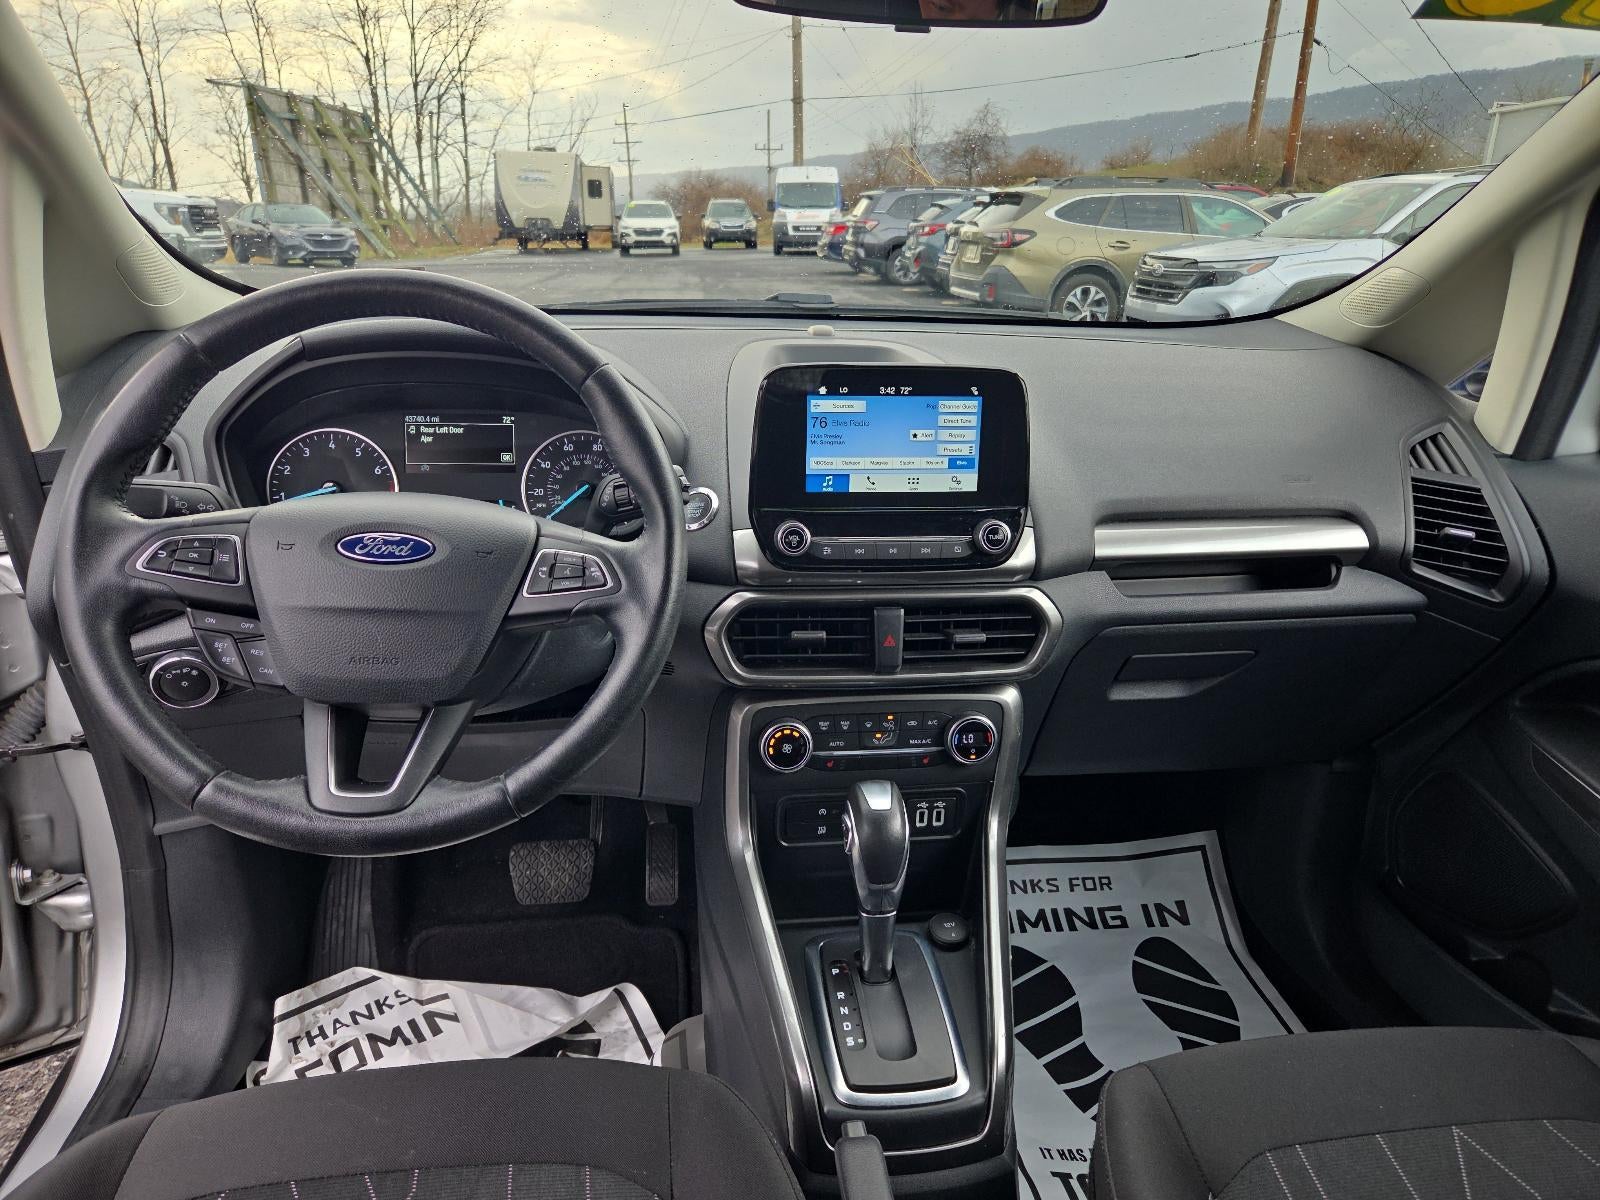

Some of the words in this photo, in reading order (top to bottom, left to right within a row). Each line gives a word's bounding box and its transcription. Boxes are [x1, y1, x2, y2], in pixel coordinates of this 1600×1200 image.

[838, 386, 849, 394] LO
[879, 386, 896, 395] 3:42
[900, 386, 913, 395] 72°
[404, 415, 430, 423] 43740.4
[431, 415, 440, 423] mi
[502, 416, 515, 424] 72°
[810, 416, 828, 429] 76
[831, 419, 848, 427] Elvis
[849, 419, 870, 427] Radio
[420, 425, 435, 434] Rear
[436, 425, 449, 434] Left
[449, 425, 464, 434] Door
[420, 435, 434, 444] Ajar
[329, 440, 336, 449] 4
[563, 443, 574, 451] 60
[592, 443, 603, 451] 80
[303, 447, 310, 457] 3
[355, 447, 361, 457] 5
[540, 461, 551, 469] 40
[284, 465, 291, 475] 2
[374, 465, 381, 475] 6
[280, 492, 285, 501] 1
[533, 488, 544, 496] 20
[355, 534, 414, 556] Ford
[214, 641, 228, 649] SET
[349, 656, 400, 665] AIRBAG
[1068, 876, 1113, 892] FOR
[1009, 904, 1129, 934] MING
[1140, 899, 1191, 928] IN
[831, 967, 840, 975] P
[836, 991, 846, 1000] R
[840, 1006, 849, 1015] N
[287, 989, 414, 1055] THANKS
[843, 1021, 852, 1031] D
[846, 1036, 855, 1047] S
[1039, 1146, 1054, 1160] IT
[1056, 1148, 1088, 1163] HAS
